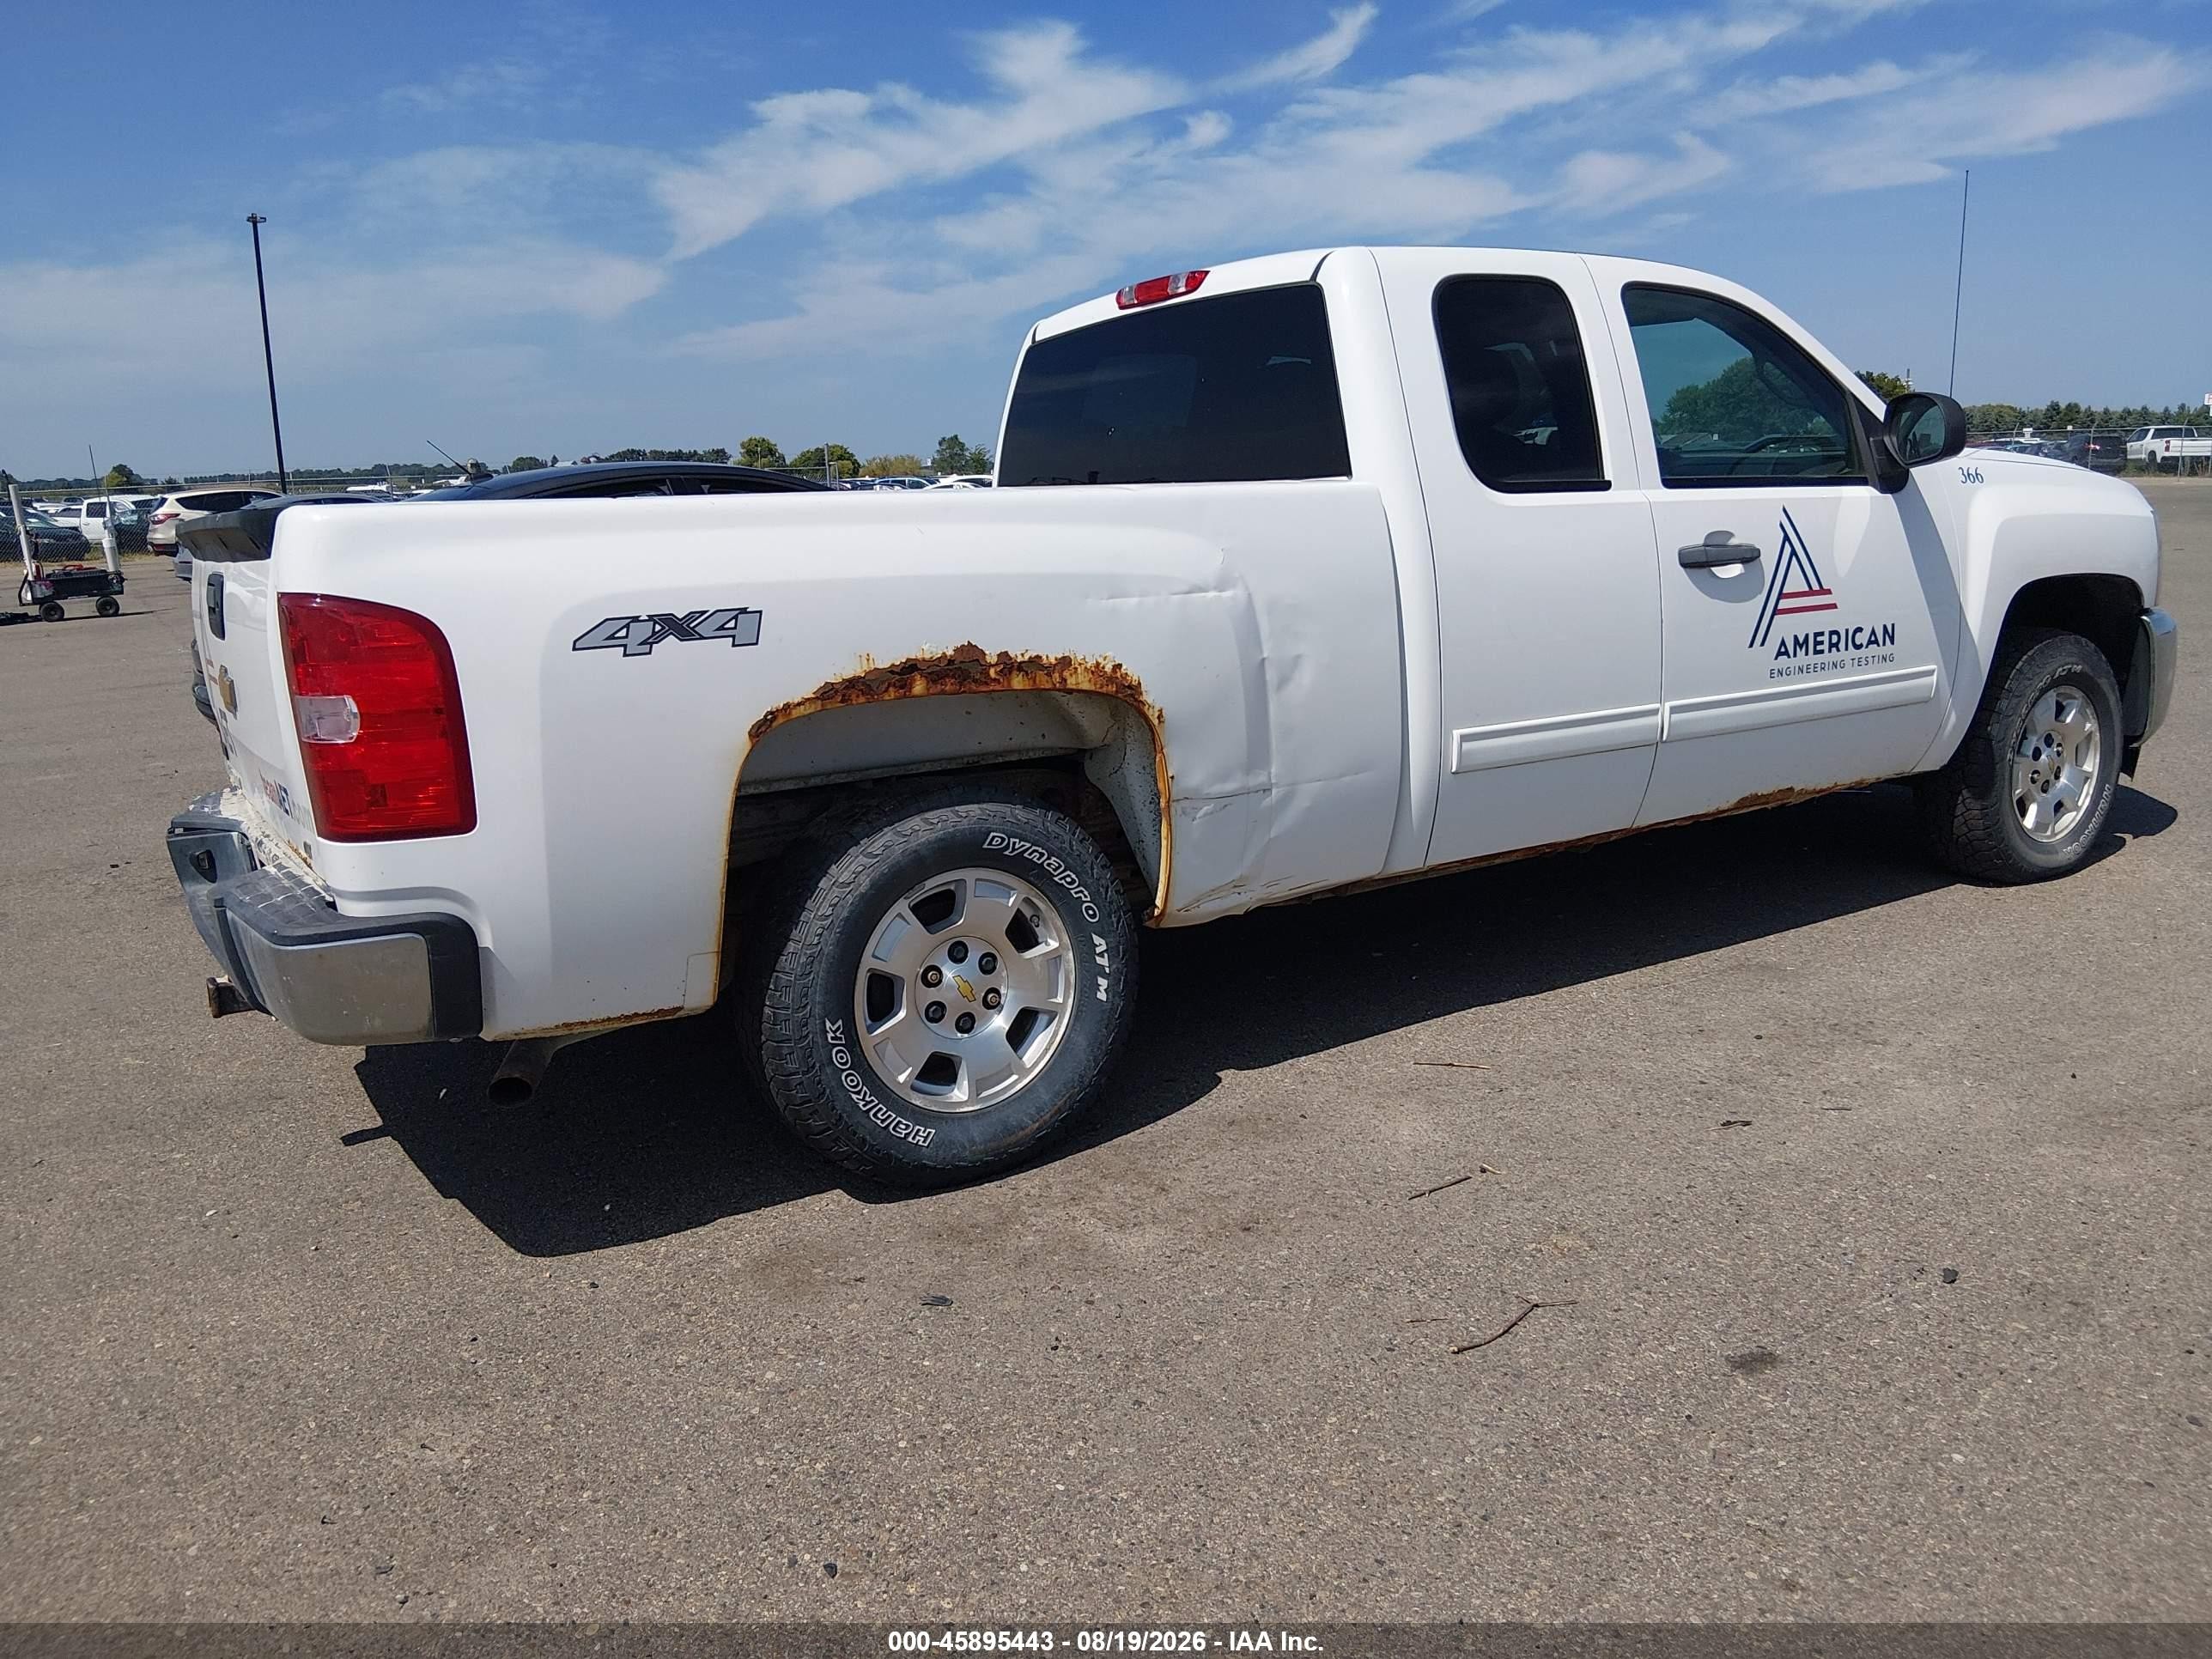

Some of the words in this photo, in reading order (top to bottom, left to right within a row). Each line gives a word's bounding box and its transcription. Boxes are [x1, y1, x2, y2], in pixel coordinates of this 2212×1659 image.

[1958, 466, 1984, 484] 366
[1773, 623, 1895, 660] AMERICAN
[1769, 659, 1845, 679] ENGINEERING
[1850, 653, 1895, 667] TESTING
